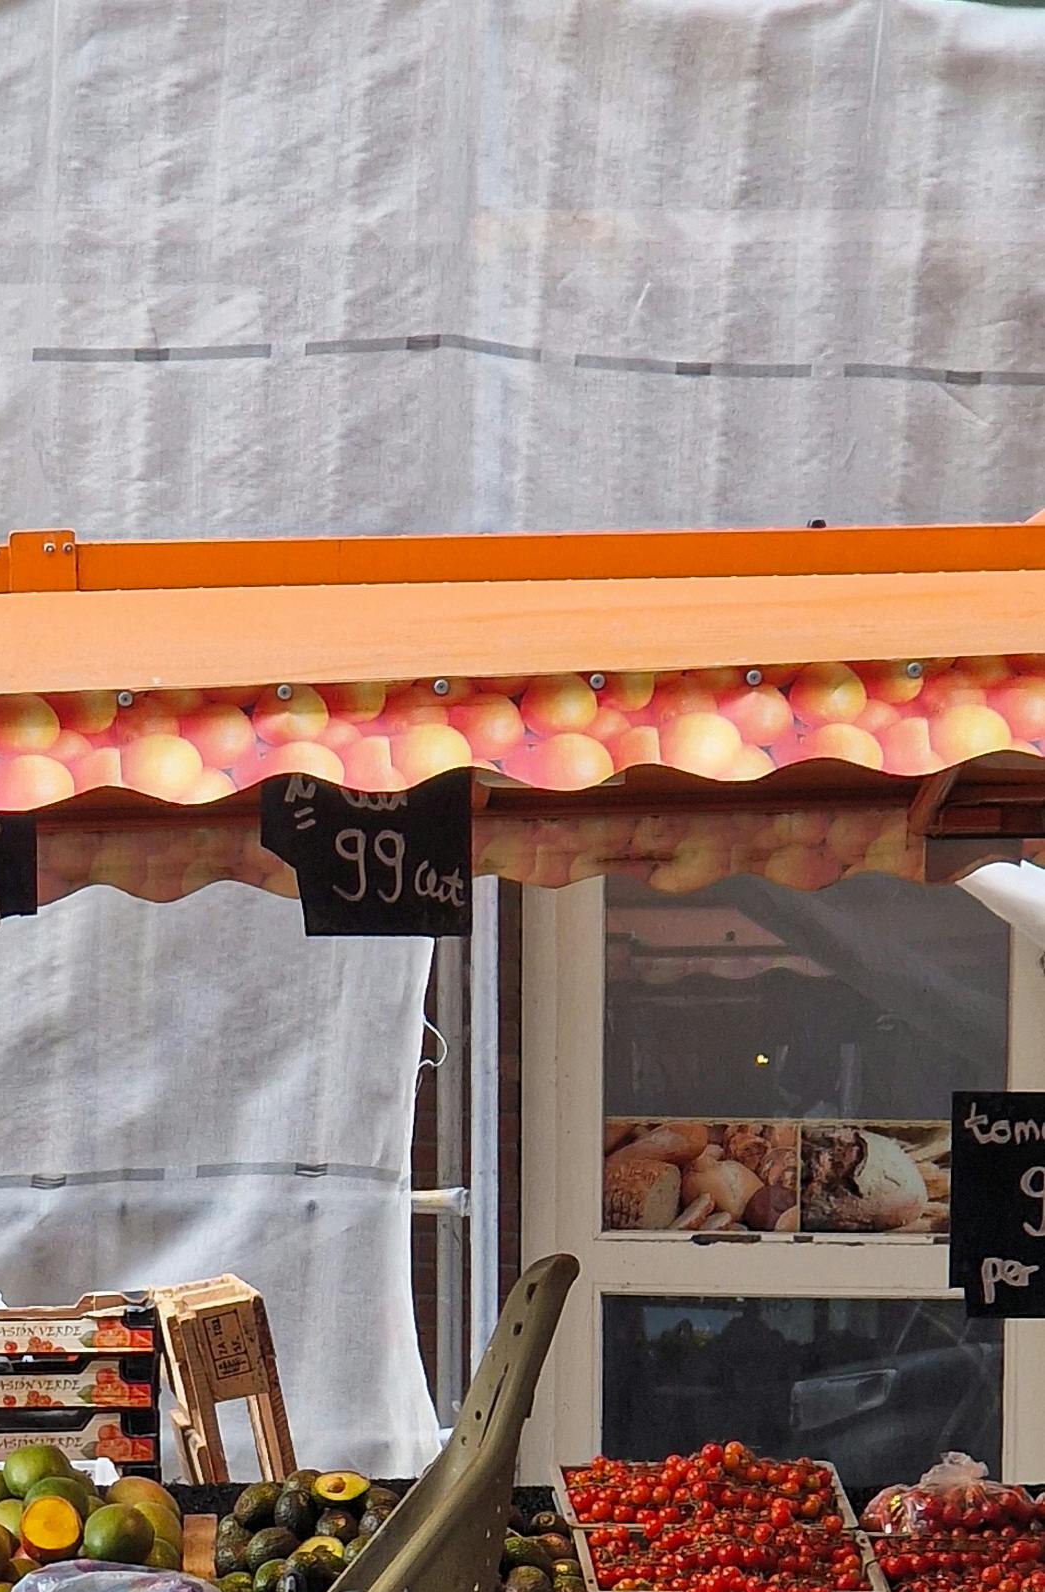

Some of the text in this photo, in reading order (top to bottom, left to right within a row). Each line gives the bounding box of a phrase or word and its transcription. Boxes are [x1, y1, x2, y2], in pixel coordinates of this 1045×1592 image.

[333, 829, 405, 903] 99
[964, 1102, 1045, 1144] tom
[982, 1257, 1039, 1303] per
[38, 1326, 82, 1337] VERDE
[38, 1379, 81, 1390] VERDE
